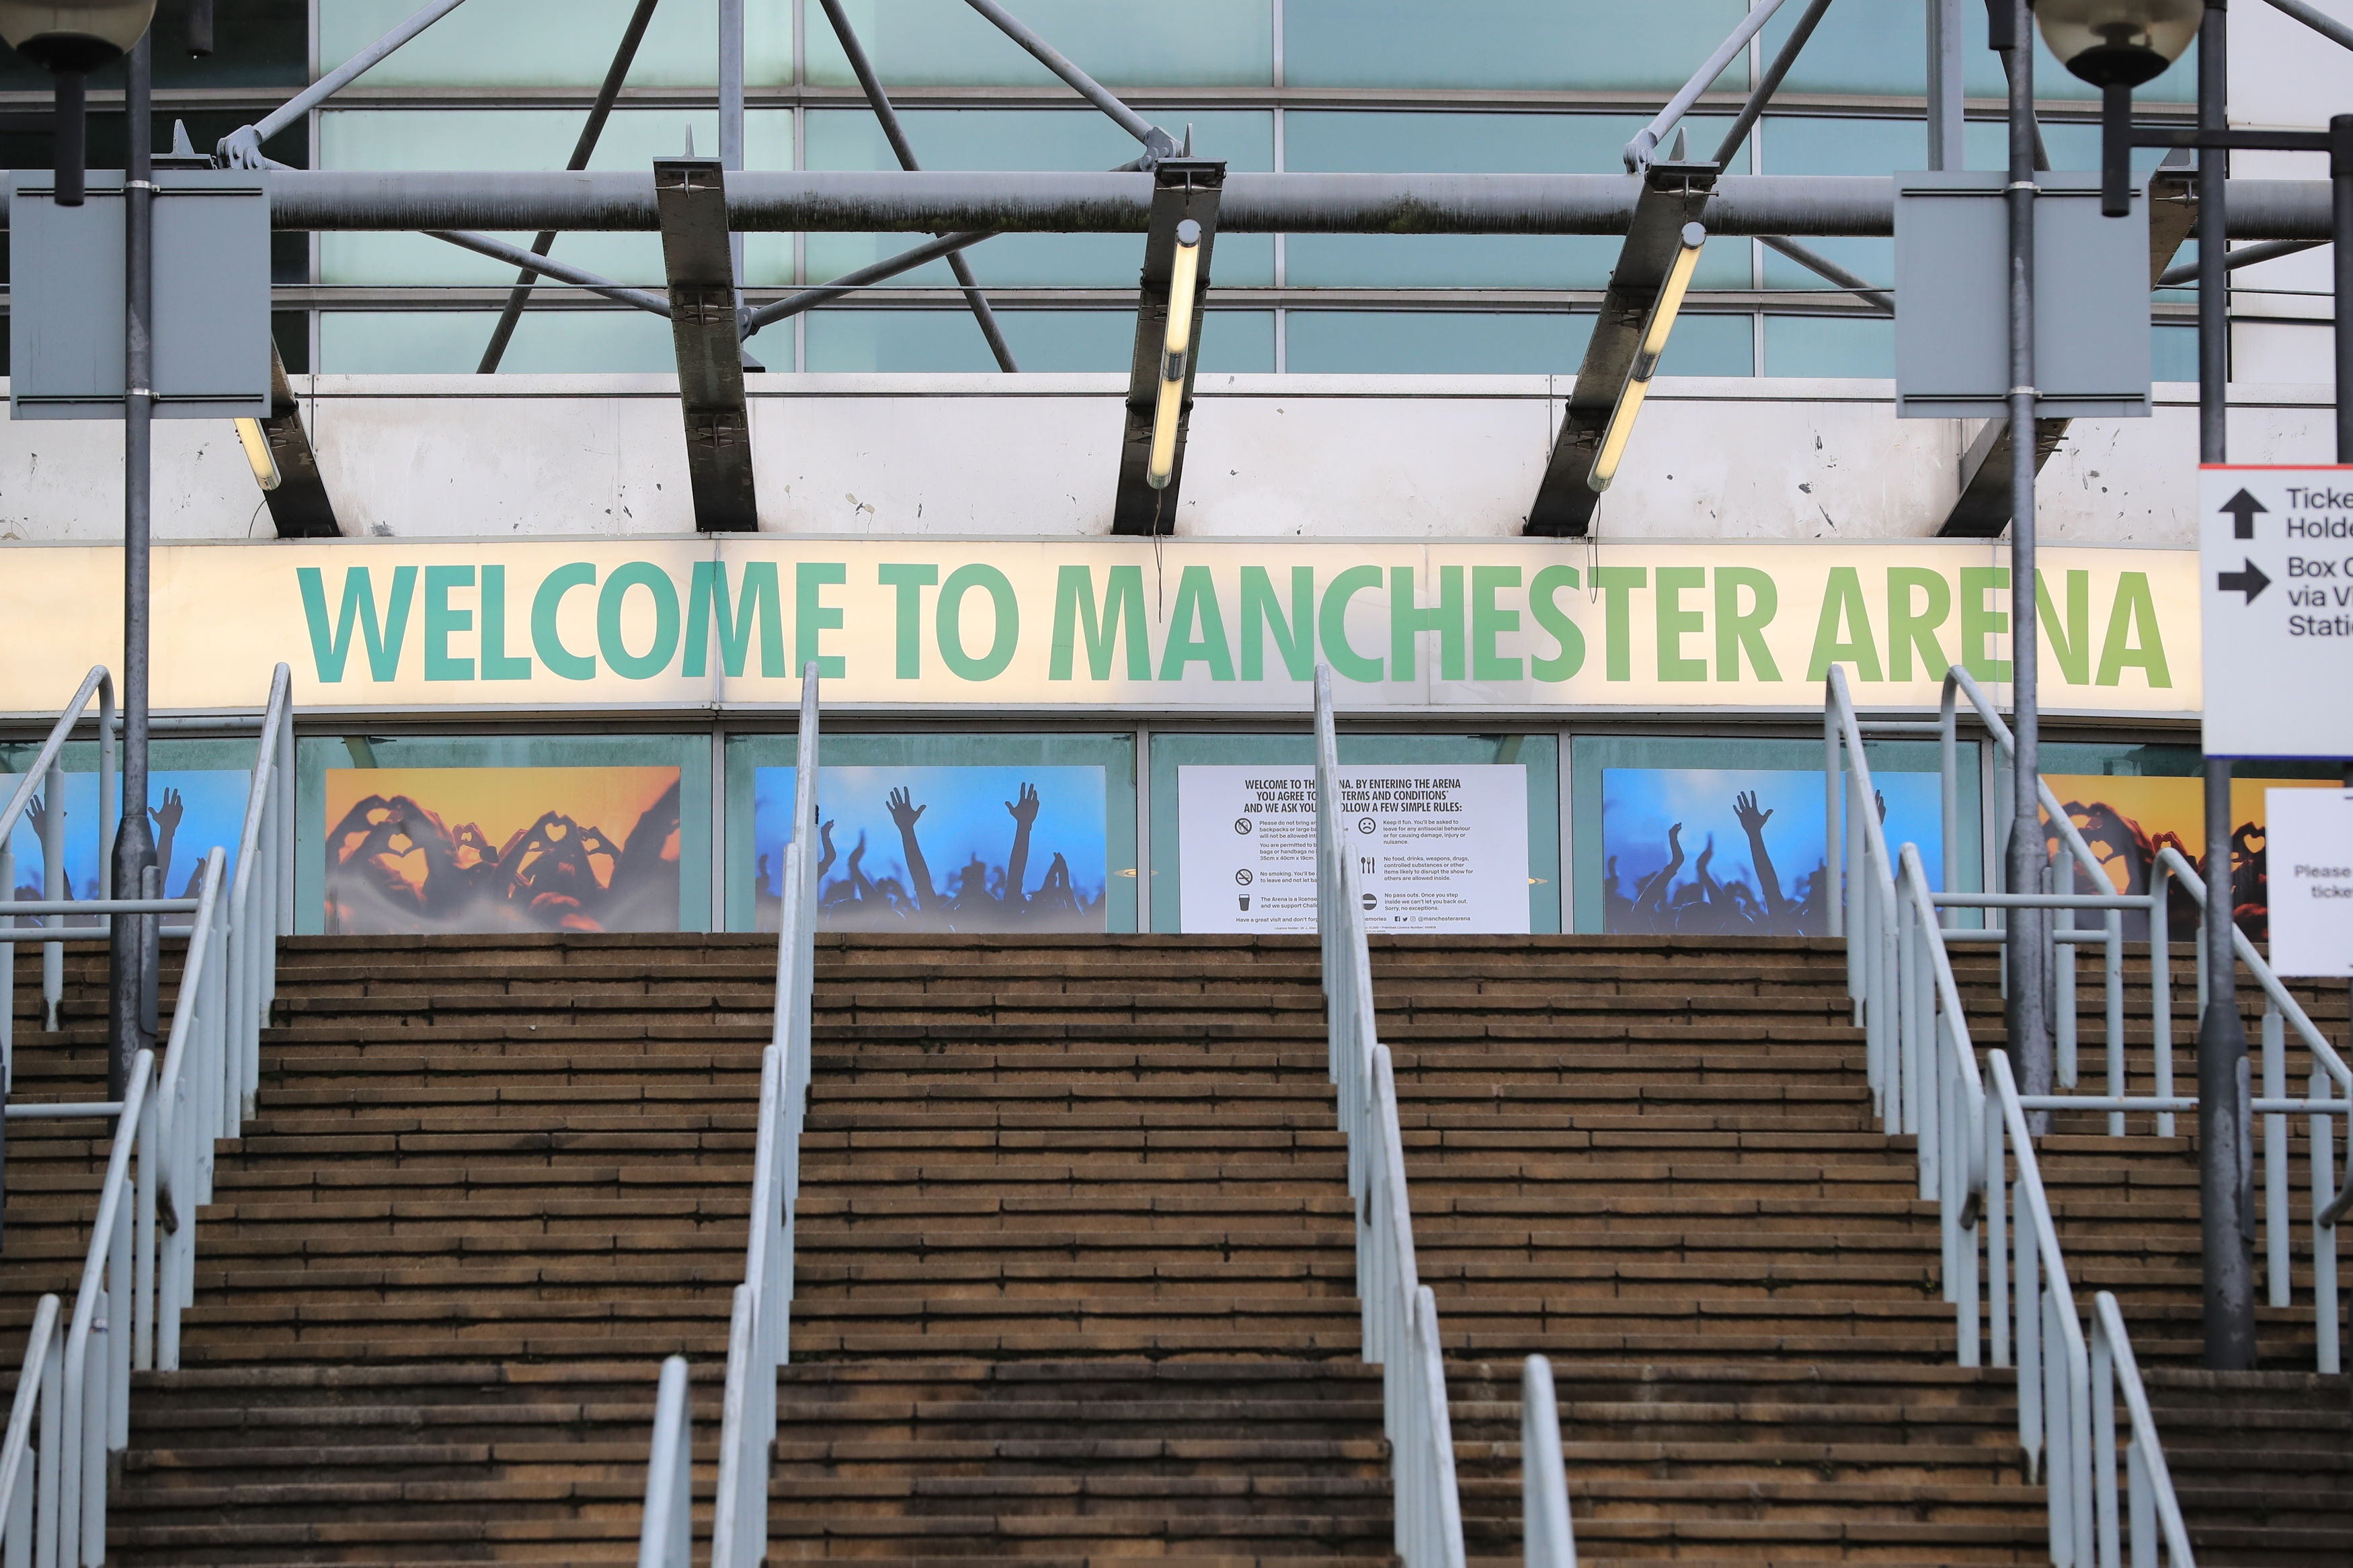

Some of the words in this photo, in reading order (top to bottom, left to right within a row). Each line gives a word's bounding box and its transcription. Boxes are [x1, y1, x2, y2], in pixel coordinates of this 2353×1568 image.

[2288, 517, 2353, 538] Hold
[2288, 556, 2336, 577] Box
[2288, 585, 2325, 606] via
[296, 561, 846, 683] WELCOME
[878, 563, 1019, 682] TO
[1049, 564, 1784, 684] MANCHESTER
[1806, 567, 2173, 689] ARENA
[2289, 614, 2353, 636] Stati
[1245, 780, 1288, 789] WELCOME
[1290, 780, 1302, 789] TO
[1304, 780, 1315, 789] TH
[1356, 780, 1367, 789] BY
[1369, 780, 1412, 789] ENTERING
[1414, 779, 1430, 788] THE
[1433, 779, 1461, 788] ARENA
[1257, 791, 1275, 801] YOU
[1277, 791, 1304, 801] AGREE
[1307, 791, 1316, 800] TO
[1342, 791, 1370, 800] TERMS
[1372, 791, 1391, 800] AND
[1244, 803, 1263, 813] AND
[1265, 803, 1279, 813] WE
[1281, 803, 1297, 813] ASK
[1300, 803, 1316, 813] YOU
[1372, 803, 1378, 812] A
[1381, 802, 1399, 812] FEW
[1401, 802, 1431, 812] SIMPLE
[1433, 802, 1462, 812] RULES:
[2295, 864, 2352, 878] Please
[2311, 884, 2353, 899] ticke
